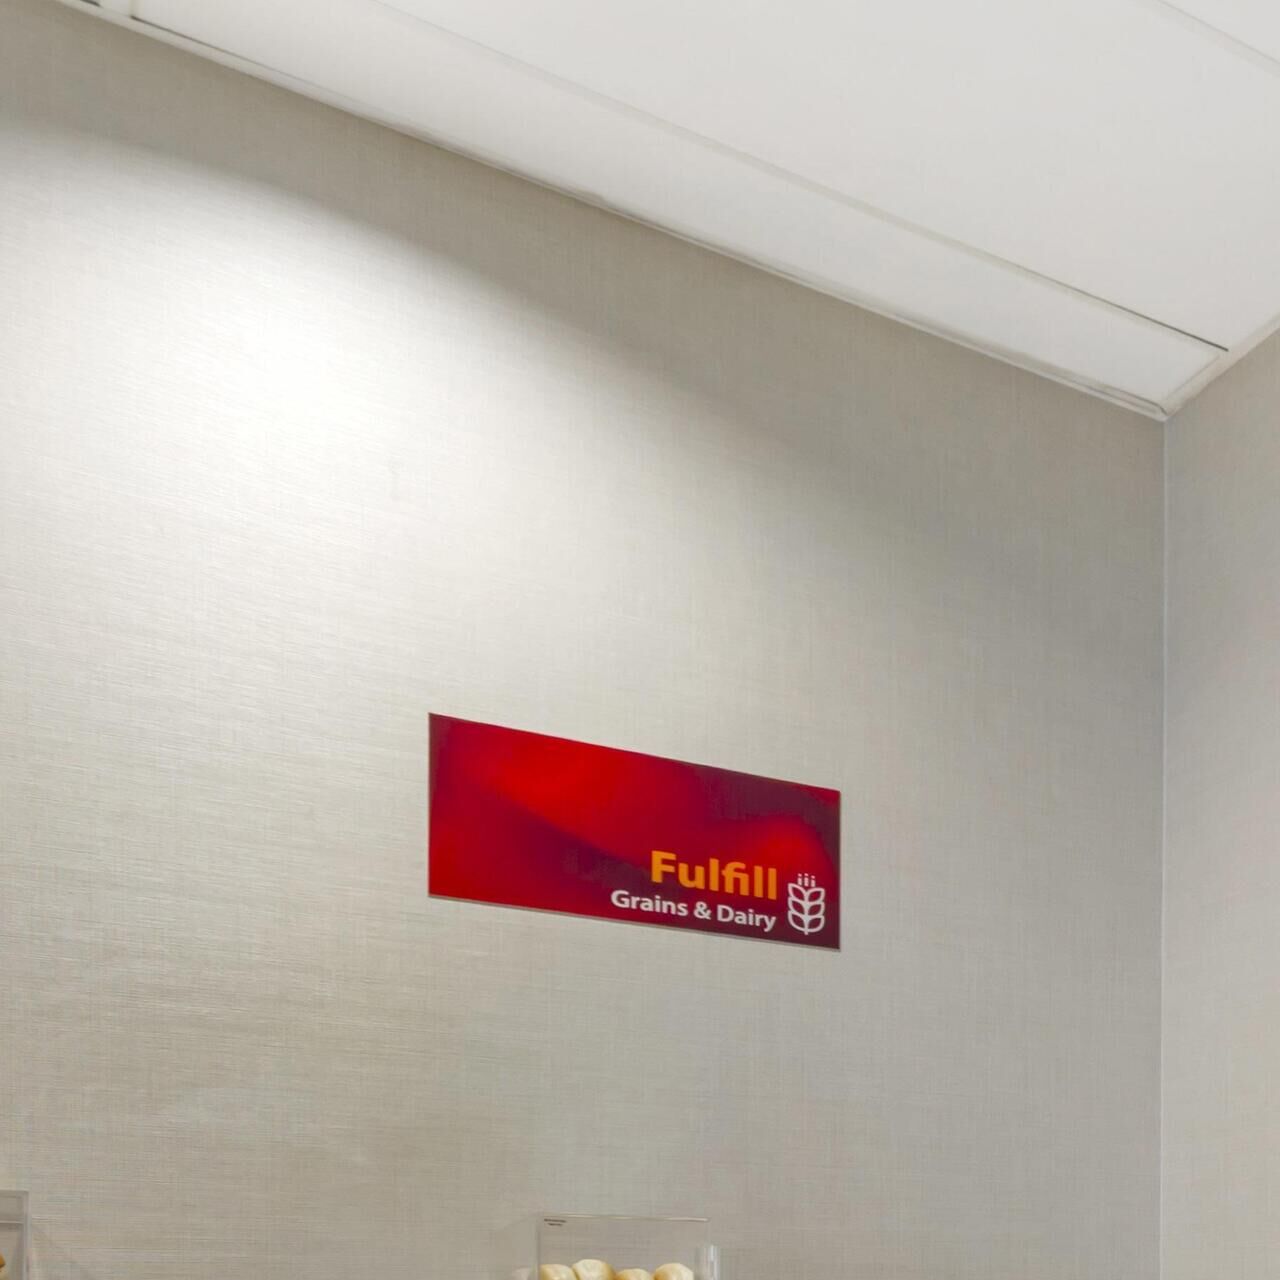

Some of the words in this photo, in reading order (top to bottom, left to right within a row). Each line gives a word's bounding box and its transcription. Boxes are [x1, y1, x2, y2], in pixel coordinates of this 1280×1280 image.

[651, 850, 777, 900] Fulfill
[610, 889, 689, 918] Grains
[694, 901, 712, 920] &
[716, 904, 777, 932] Dairy
